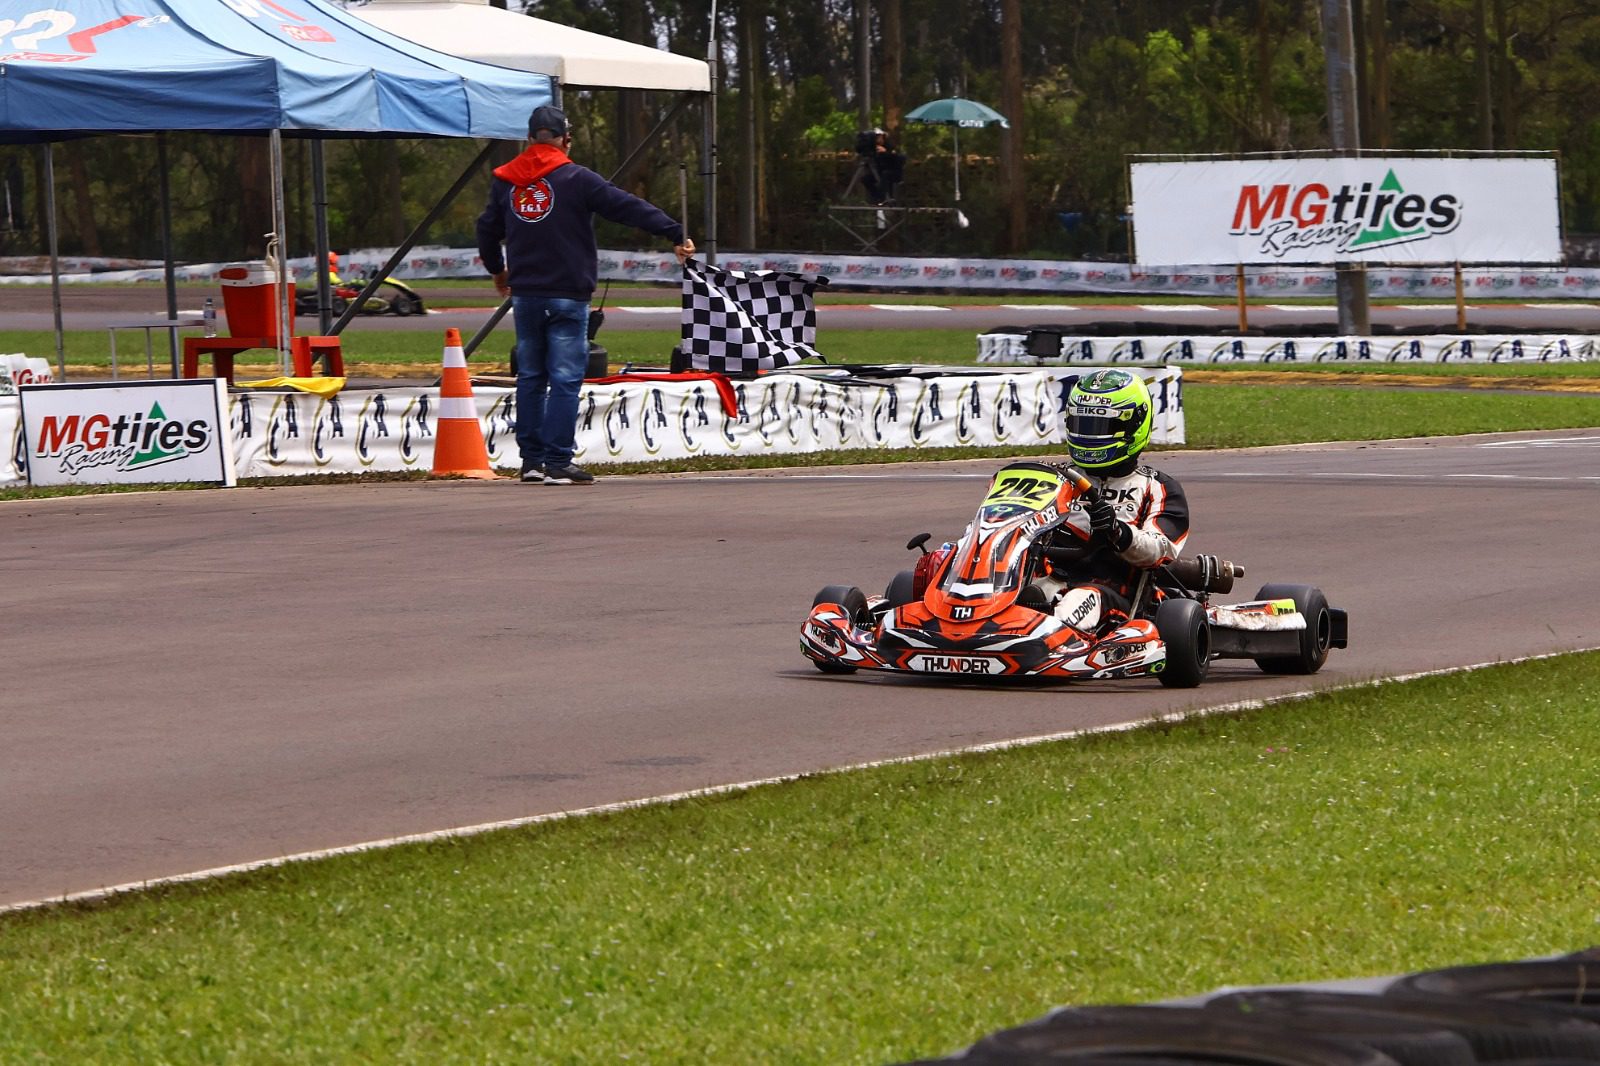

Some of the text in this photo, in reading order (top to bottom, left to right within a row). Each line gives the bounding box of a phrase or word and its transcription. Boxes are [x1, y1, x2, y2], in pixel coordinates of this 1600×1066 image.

[1232, 183, 1459, 230] MGtires
[1262, 220, 1362, 251] Racing
[37, 412, 208, 454] MGtires
[60, 444, 135, 470] Racing
[988, 477, 1058, 502] 202
[1020, 505, 1059, 537] THUNDER
[954, 606, 972, 619] TH
[922, 656, 990, 674] THUNDER
